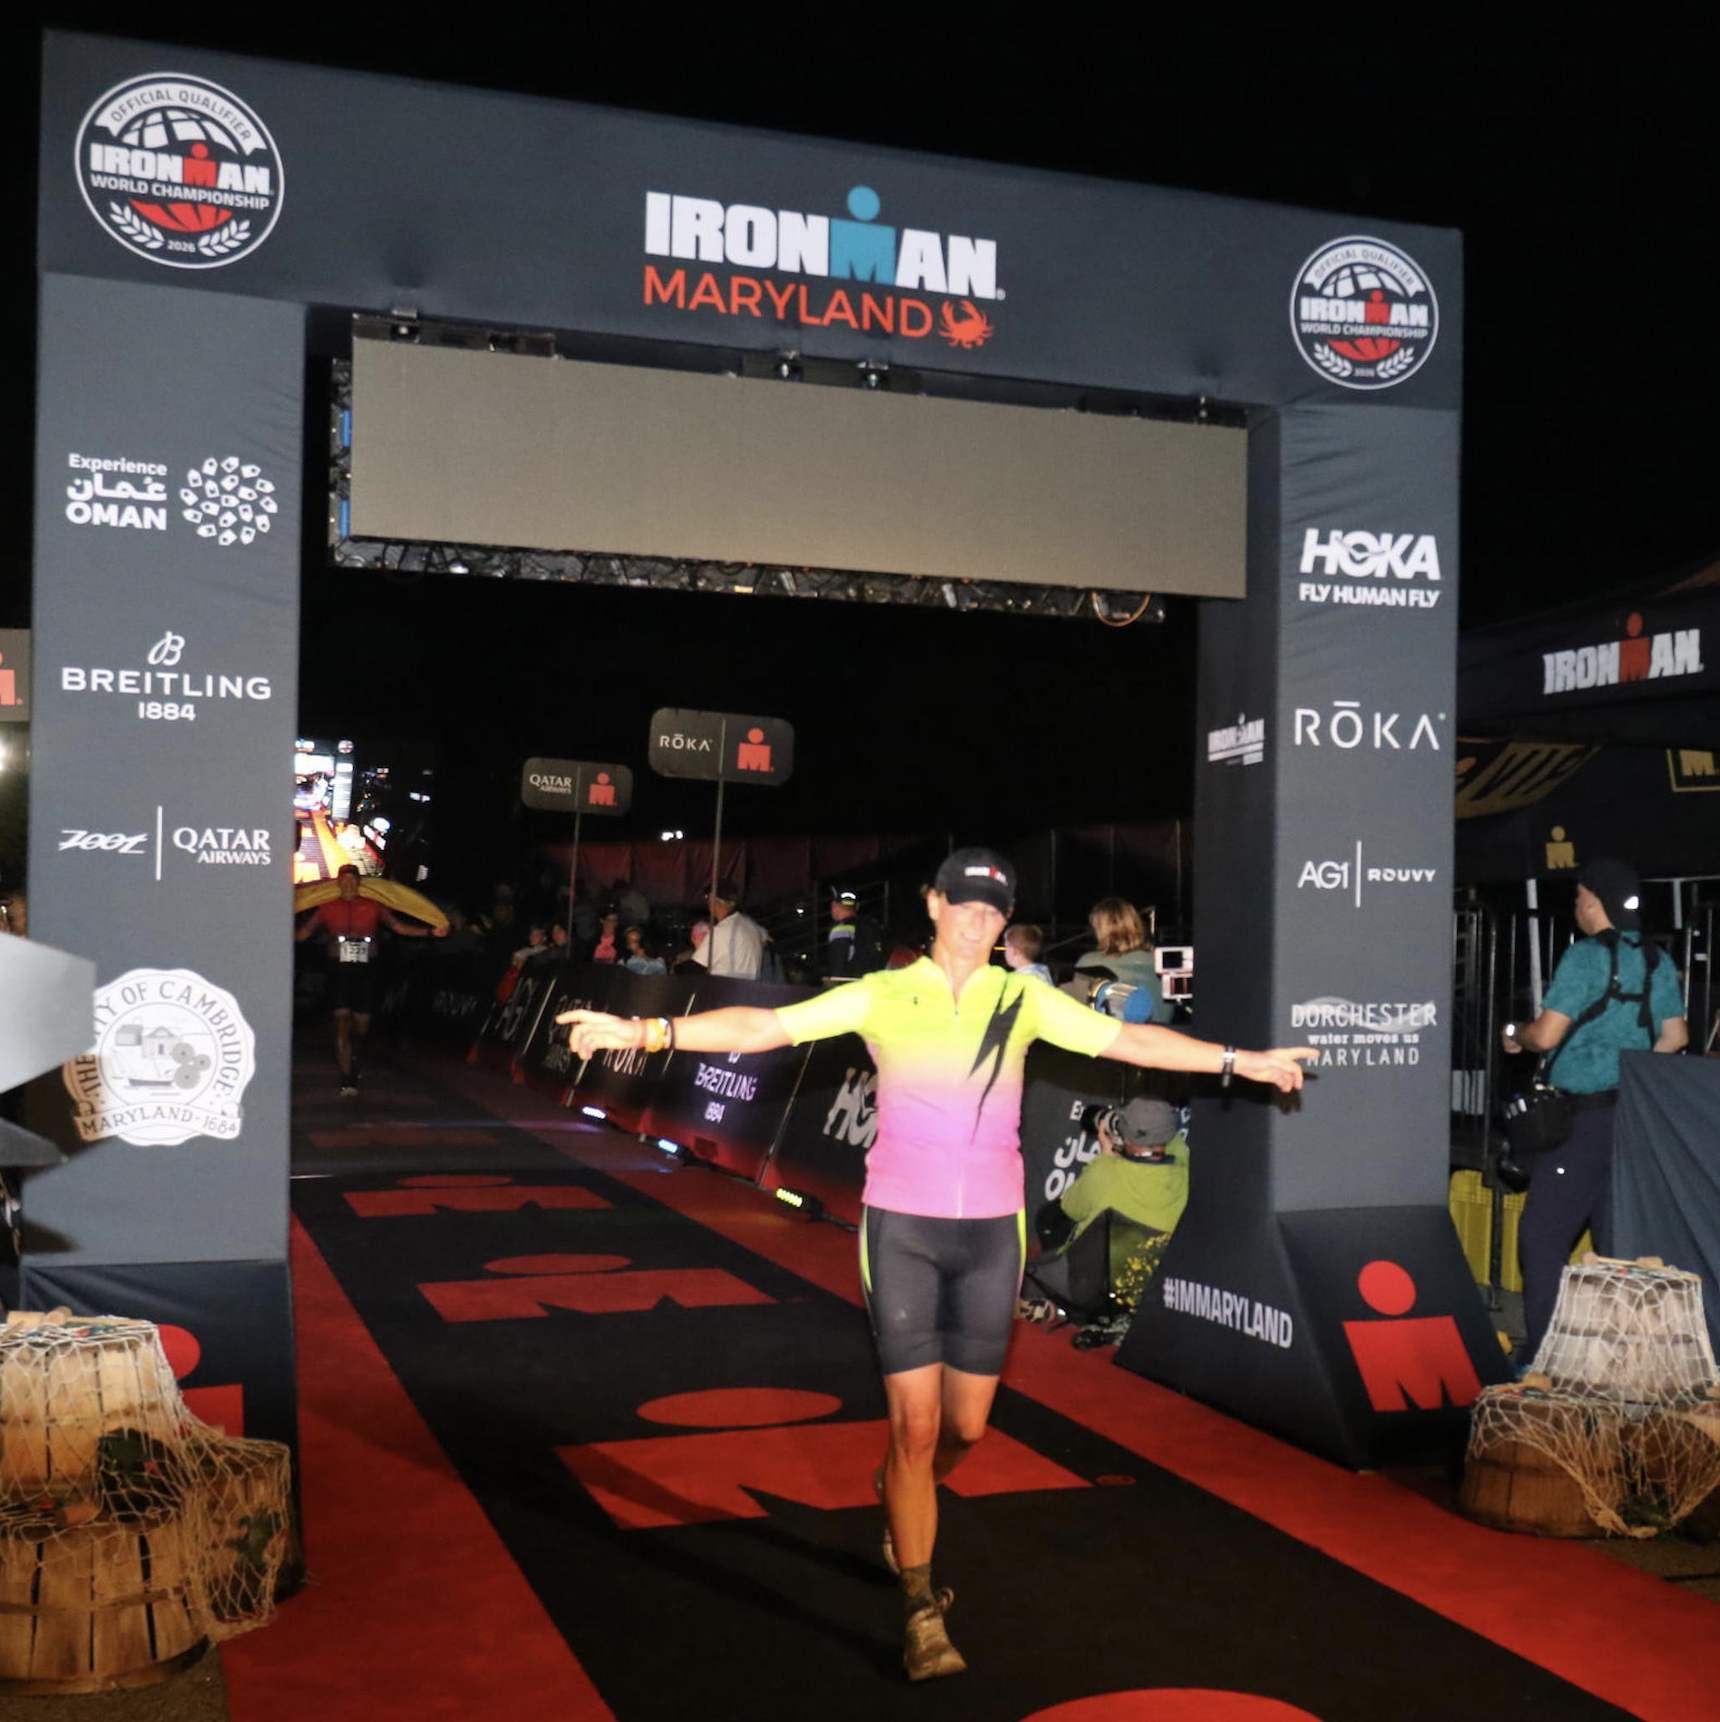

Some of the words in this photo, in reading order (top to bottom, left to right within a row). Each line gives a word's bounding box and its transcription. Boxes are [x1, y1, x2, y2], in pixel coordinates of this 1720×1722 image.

[111, 89, 173, 122] OFFICIAL
[179, 90, 252, 141] QUALIFIER
[90, 142, 270, 195] IRONMAN
[90, 173, 149, 194] WORLD
[151, 183, 270, 210] CHAMPIONSHIP
[167, 240, 196, 253] 2026
[645, 185, 997, 300] IRONMAN
[644, 266, 932, 337] MARYLAND
[1300, 289, 1429, 327] IRONMAN
[1301, 322, 1341, 336] WORLD
[1342, 324, 1428, 339] CHAMPIONSHIP
[69, 453, 167, 476] Experience
[66, 501, 167, 530] OMAN
[1300, 528, 1441, 580] HOKA
[1299, 583, 1330, 602] FLY
[1332, 586, 1407, 606] HUMAN
[1408, 589, 1440, 608] FLY
[1542, 612, 1700, 695] IRONMAN
[62, 667, 271, 700] BREITLING
[138, 702, 196, 721] 1884
[529, 773, 572, 788] QATAR
[172, 827, 270, 854] QATAR
[198, 851, 271, 866] AIRWAYS
[1297, 861, 1349, 889] AG1
[1367, 868, 1436, 882] ROUVY
[1291, 1002, 1437, 1028] DORCHESTER
[121, 981, 150, 1006] OF
[159, 979, 242, 1097] CAMBRIDGE
[1307, 1032, 1349, 1044] water
[1353, 1034, 1398, 1044] moves
[1403, 1033, 1419, 1044] us
[694, 1061, 757, 1101] BREITLING
[82, 1106, 193, 1134] MARYLAND
[1163, 1276, 1293, 1349] #IMMARYLAND
